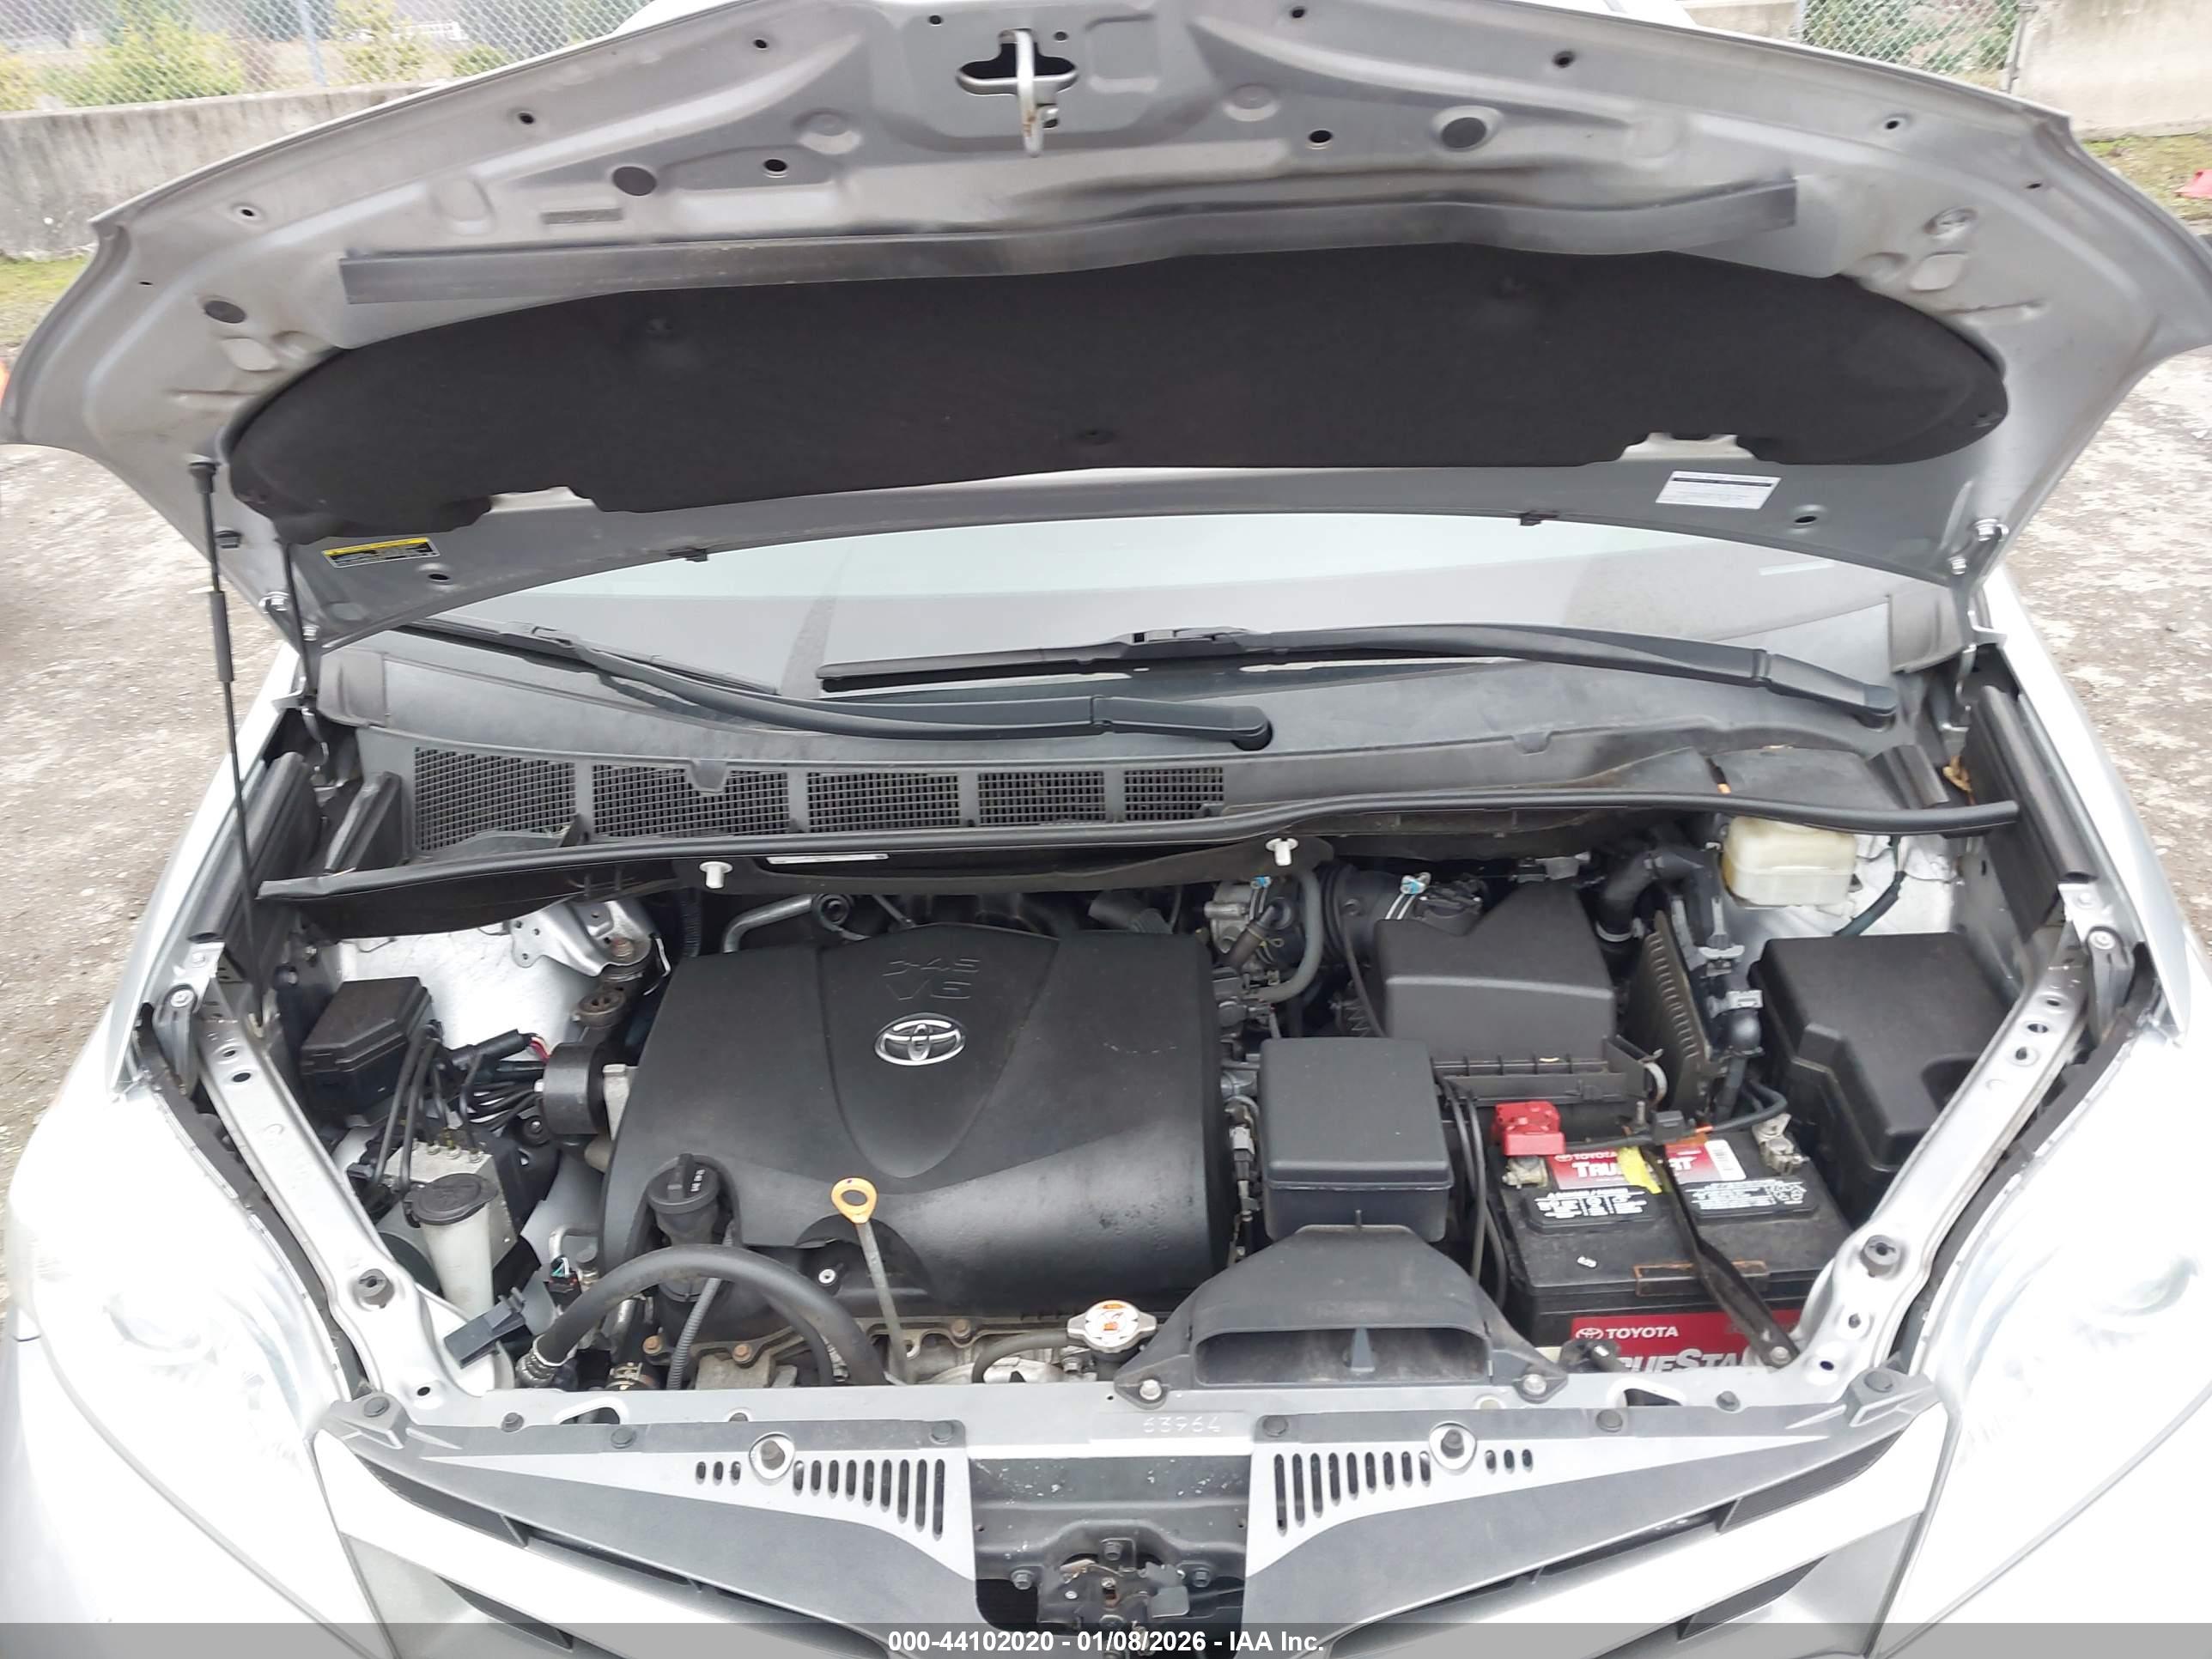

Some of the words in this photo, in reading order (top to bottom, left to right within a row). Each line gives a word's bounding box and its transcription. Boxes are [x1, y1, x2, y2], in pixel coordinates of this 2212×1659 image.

[1572, 1151, 1618, 1161] TOYOTA
[1606, 1326, 1679, 1340] TOYOTA
[1143, 1415, 1221, 1433] 63964
